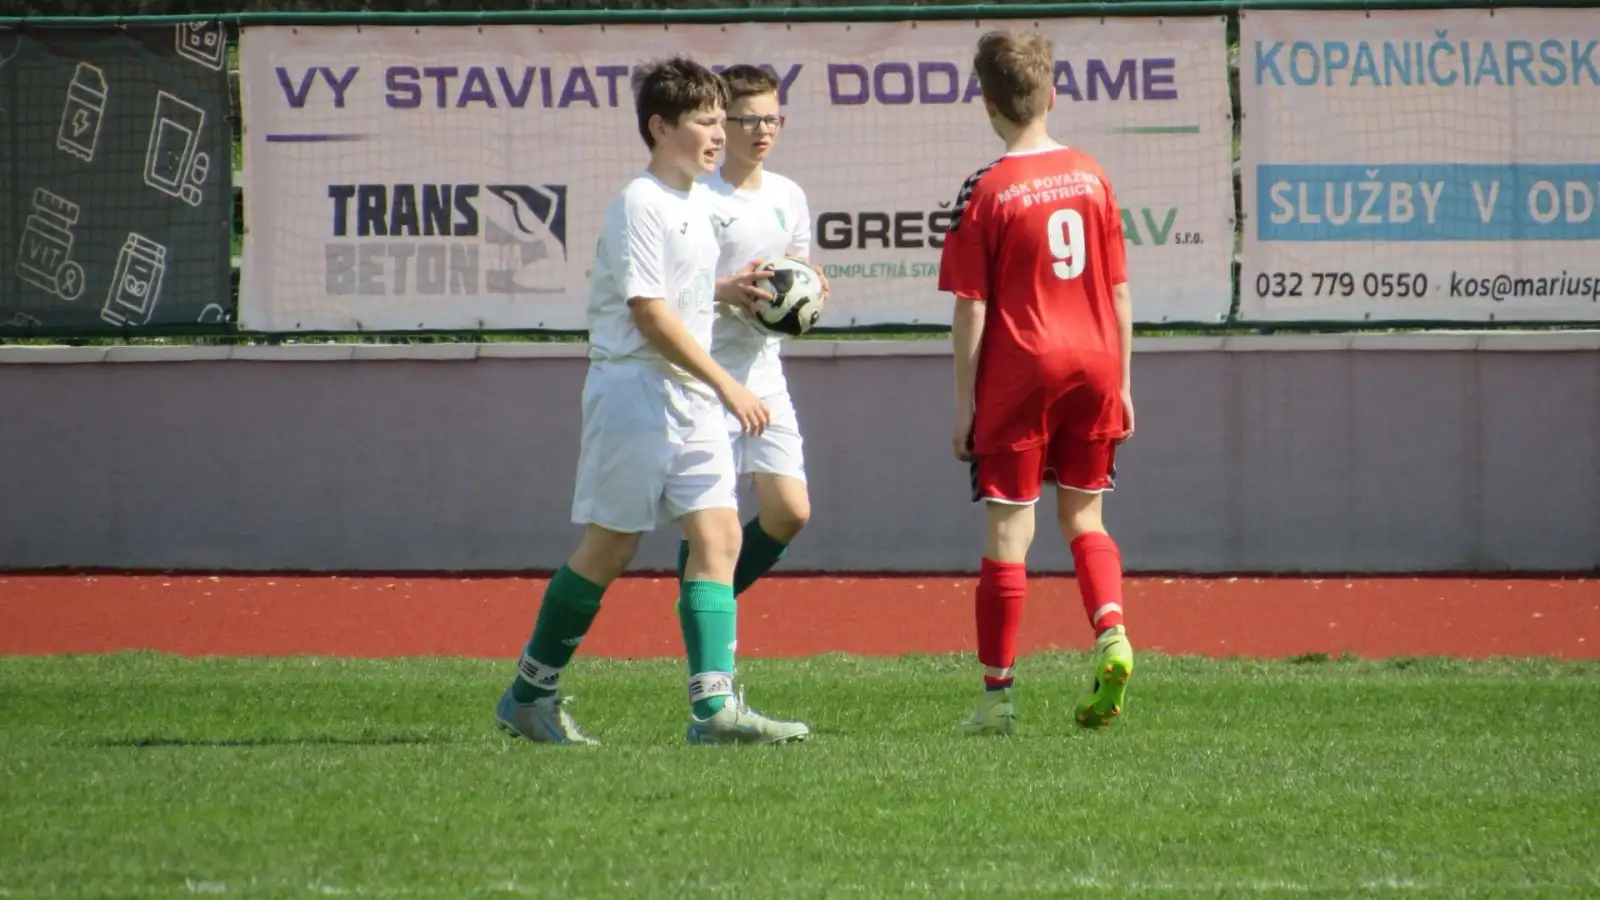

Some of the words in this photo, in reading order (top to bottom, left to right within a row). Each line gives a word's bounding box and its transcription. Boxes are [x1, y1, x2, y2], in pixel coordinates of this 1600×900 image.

[276, 66, 360, 109] VY
[385, 65, 638, 109] STAVIAT
[828, 58, 1178, 104] DODAME
[1255, 29, 1600, 87] KOPANIČIARSK
[328, 184, 479, 236] TRANS
[1269, 169, 1444, 225] SLUŽBY
[1472, 180, 1499, 224] V
[1528, 180, 1600, 224] OD
[29, 238, 62, 269] VIT
[325, 243, 479, 295] BETON
[1047, 208, 1086, 279] 9
[911, 263, 940, 277] STA
[1256, 273, 1303, 297] 032
[1311, 273, 1355, 297] 779
[1363, 273, 1428, 297] 0550
